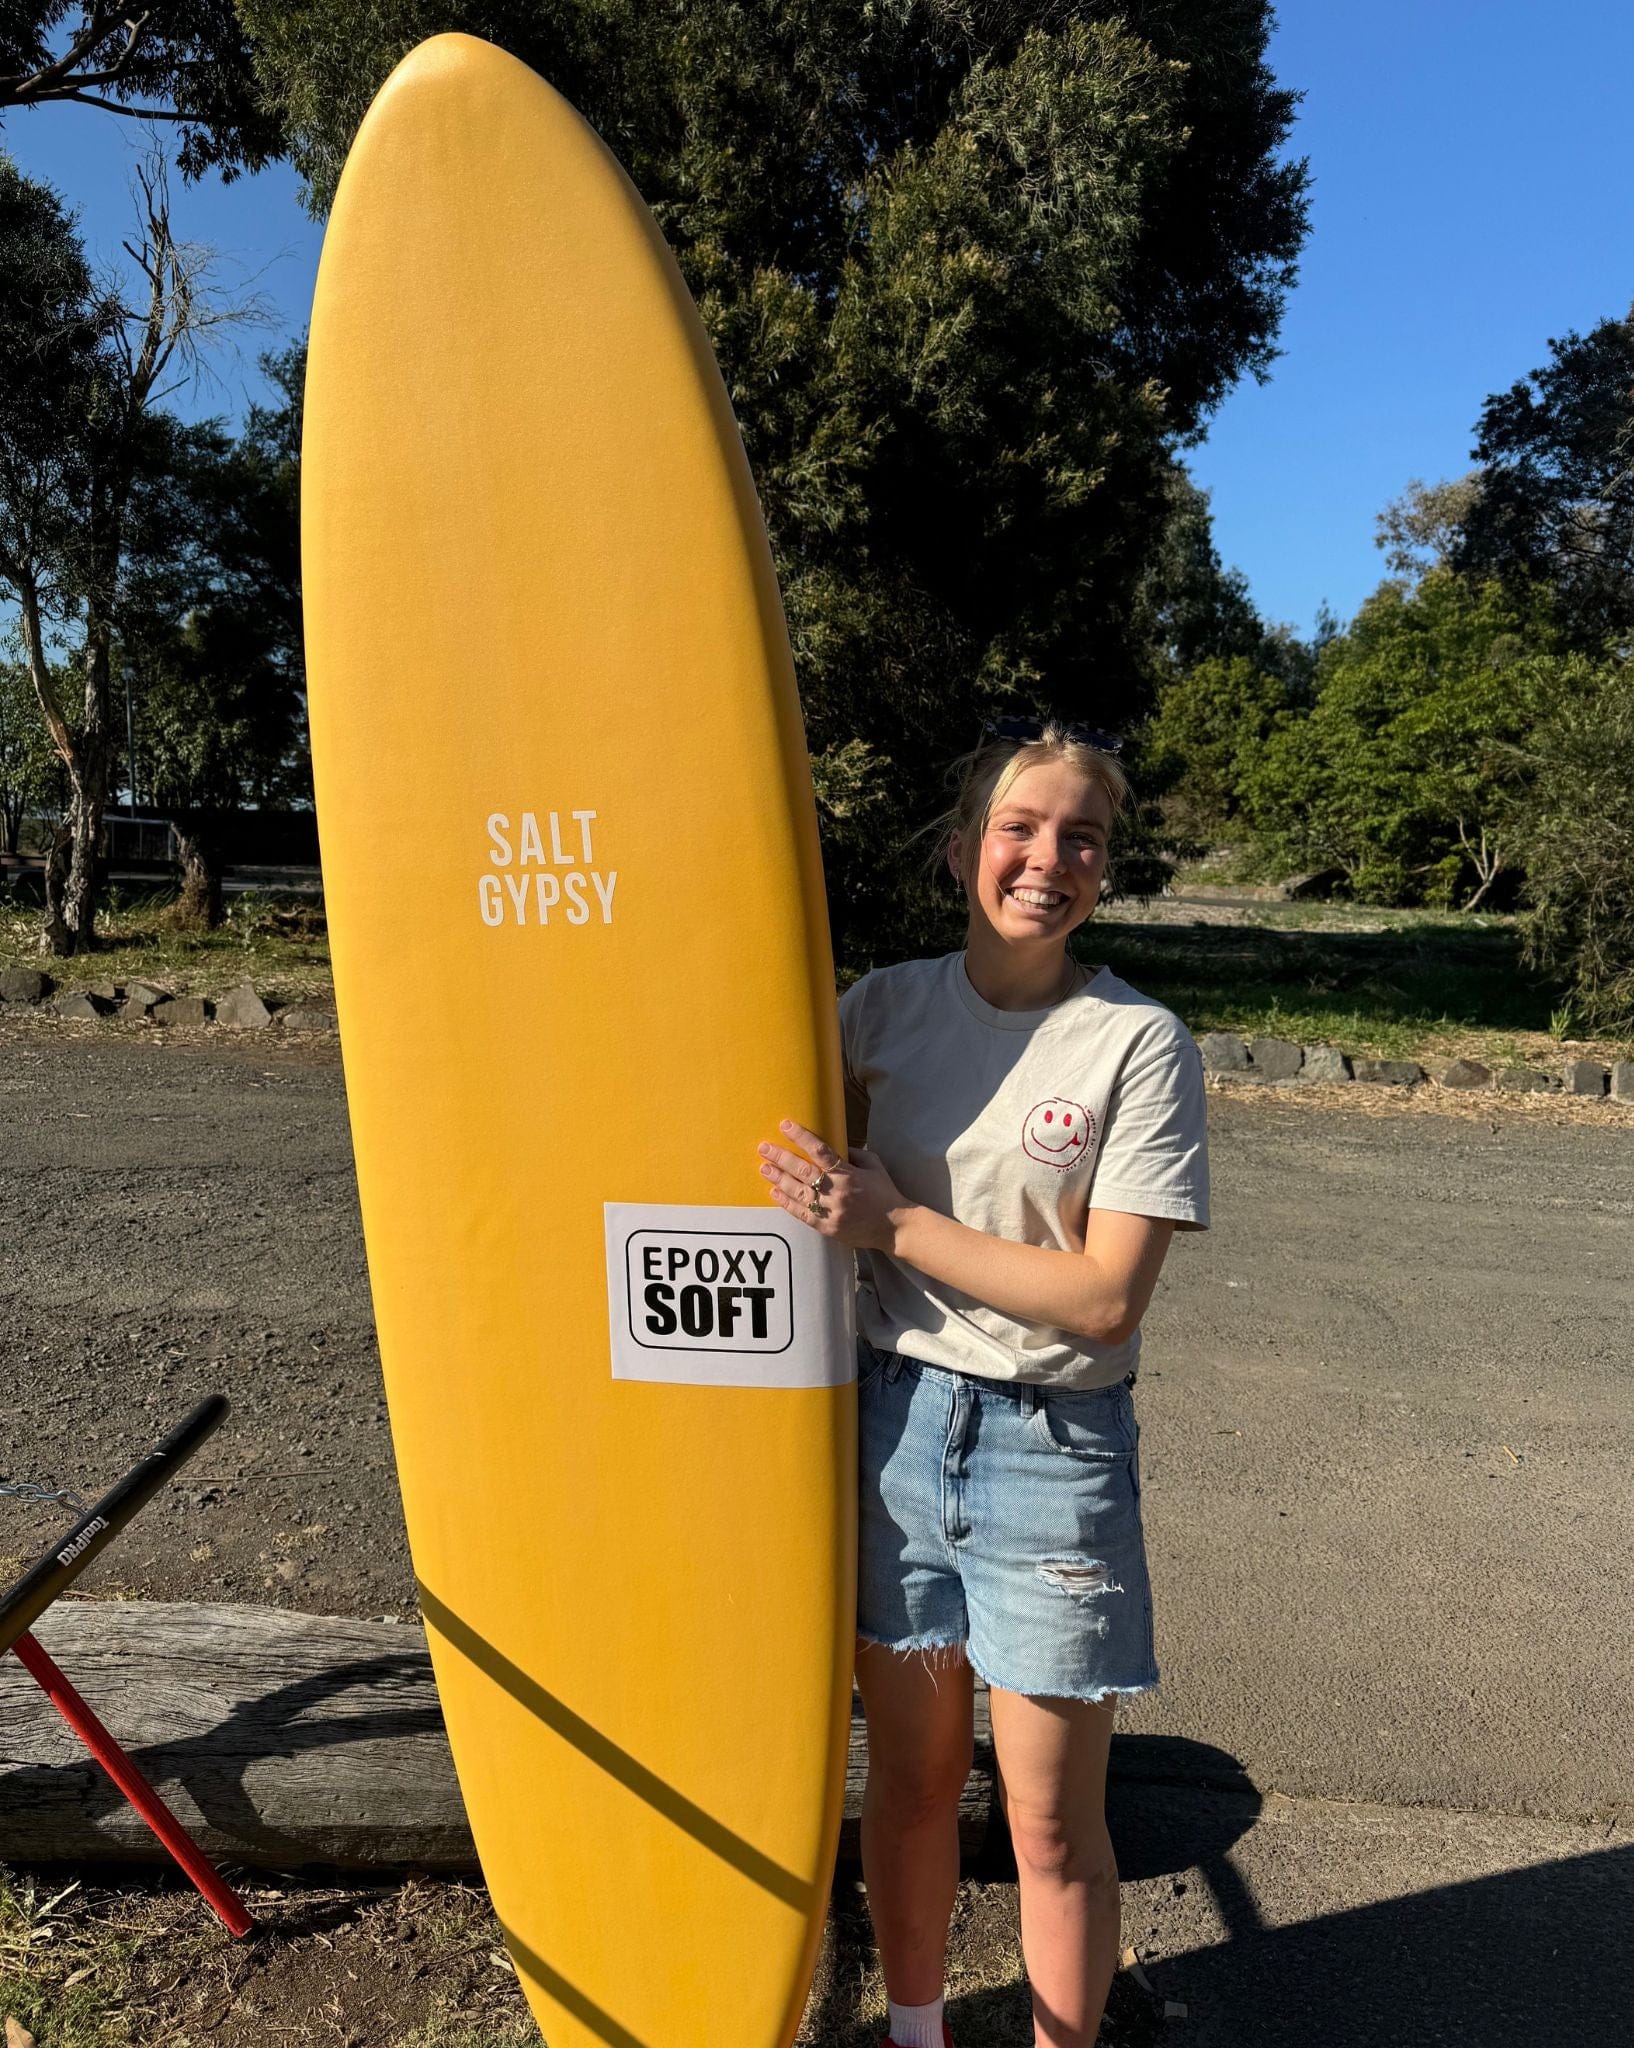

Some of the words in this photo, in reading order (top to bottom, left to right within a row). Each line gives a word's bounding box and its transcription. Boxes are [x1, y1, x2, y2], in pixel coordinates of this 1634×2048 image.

[487, 810, 597, 866] SALT
[478, 871, 617, 927] GYPSY
[643, 1246, 773, 1284] EPOXY
[643, 1283, 775, 1339] SOFT
[57, 1516, 110, 1567] ToolPRO
